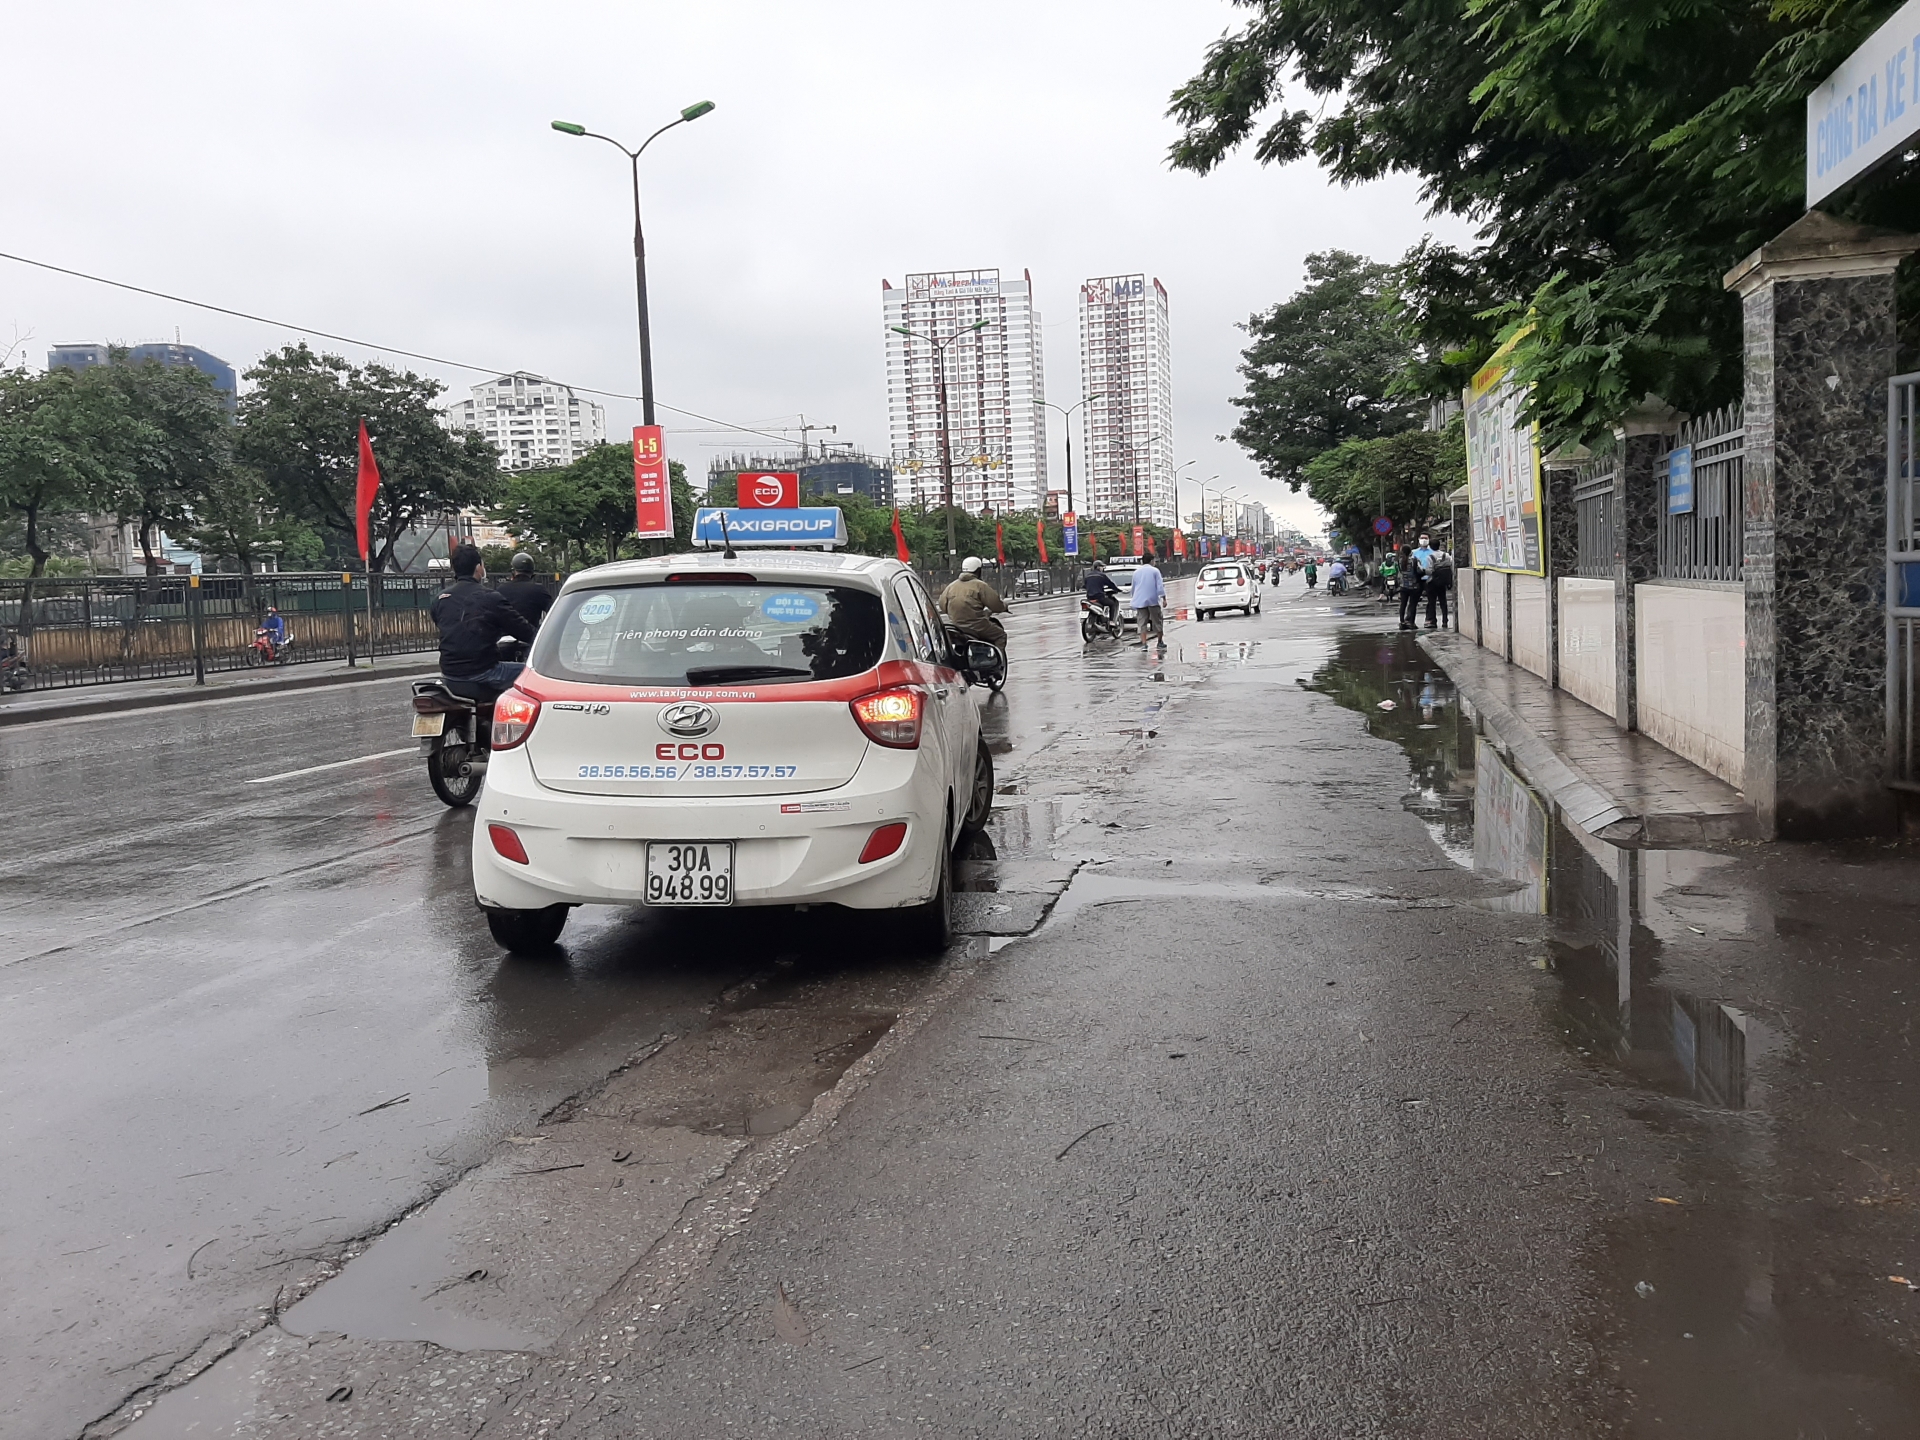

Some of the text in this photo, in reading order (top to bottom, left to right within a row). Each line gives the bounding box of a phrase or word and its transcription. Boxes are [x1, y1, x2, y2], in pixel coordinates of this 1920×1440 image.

[1857, 72, 1879, 149] RA
[1884, 46, 1907, 128] XE
[1114, 279, 1143, 297] MB
[638, 437, 657, 454] 1-5
[755, 488, 779, 496] ECO
[717, 519, 833, 532] TAXIGROUP
[583, 604, 612, 616] 9209
[793, 598, 806, 606] XE
[644, 628, 688, 641] phong
[719, 625, 763, 640] đường
[629, 688, 756, 699] www.taxigroup.com.vn
[655, 743, 725, 761] ECO
[667, 845, 711, 872] 30A
[649, 874, 729, 900] 948.99
